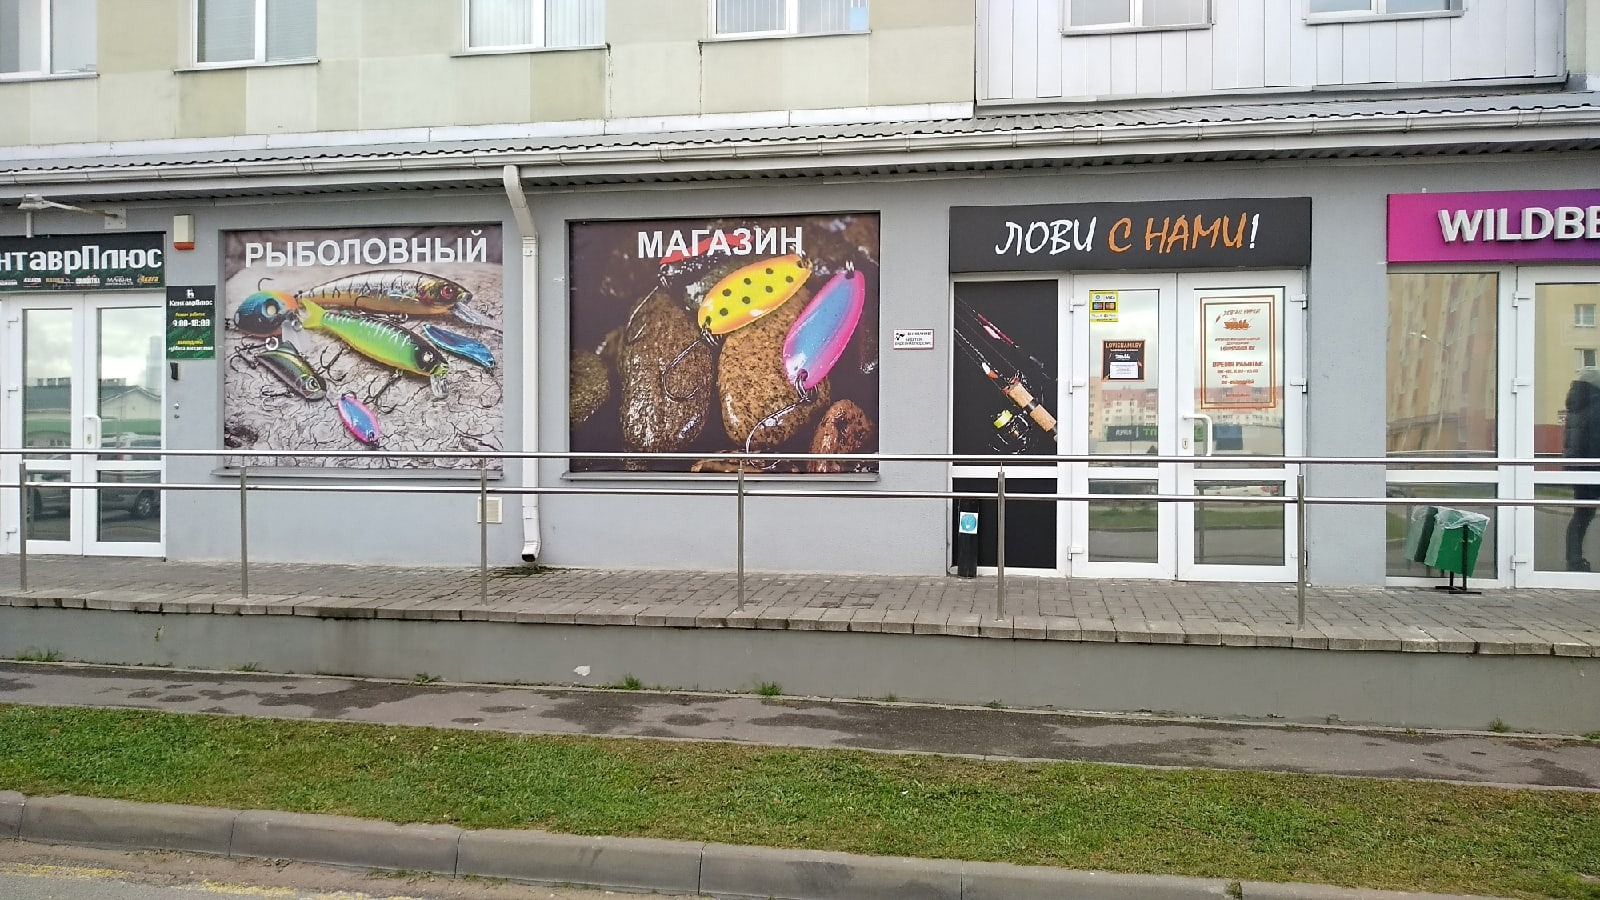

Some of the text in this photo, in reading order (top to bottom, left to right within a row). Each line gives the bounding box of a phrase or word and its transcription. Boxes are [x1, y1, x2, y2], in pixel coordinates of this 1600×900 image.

[245, 229, 487, 268] РЫБОЛОВНЫЙ
[638, 226, 803, 259] МАГАЗИН
[995, 212, 1260, 256] ЛОВИ С НАМИ!
